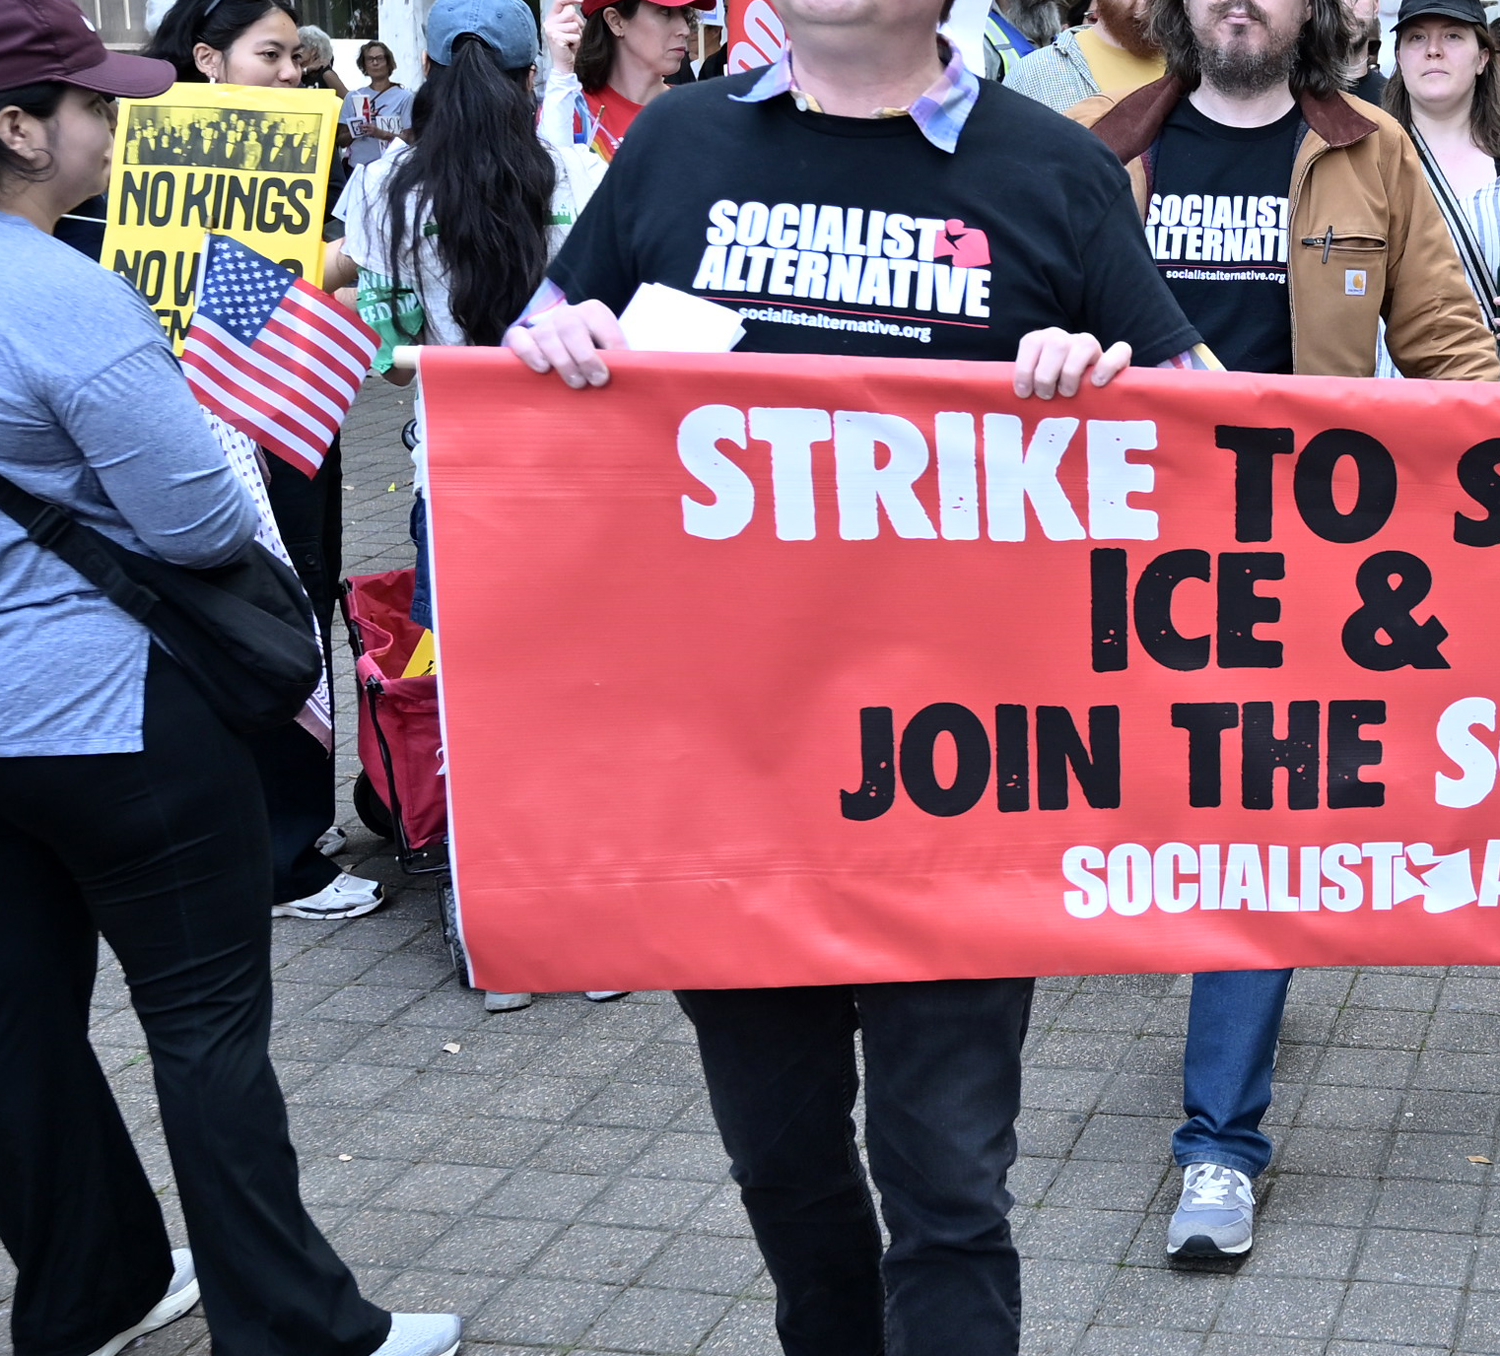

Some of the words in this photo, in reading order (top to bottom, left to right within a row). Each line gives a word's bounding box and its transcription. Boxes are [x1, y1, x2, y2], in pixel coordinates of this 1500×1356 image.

[118, 171, 175, 227] NO
[181, 173, 313, 234] KINGS
[706, 199, 945, 262] SOCIALIST
[1146, 193, 1288, 229] SOCIALIST
[1145, 226, 1288, 263] ALTERNATI
[692, 245, 992, 318] ALTERNATIVE
[1166, 269, 1286, 284] socialistalternative.org
[738, 307, 932, 343] socialistalternative.org
[676, 404, 1160, 543] STRIKE
[1215, 425, 1397, 543] TO
[1089, 548, 1285, 673] ICE
[1341, 550, 1452, 672] &
[840, 701, 1121, 822] JOIN
[1171, 699, 1386, 810] THE
[1063, 842, 1402, 919] SOCIALIST
